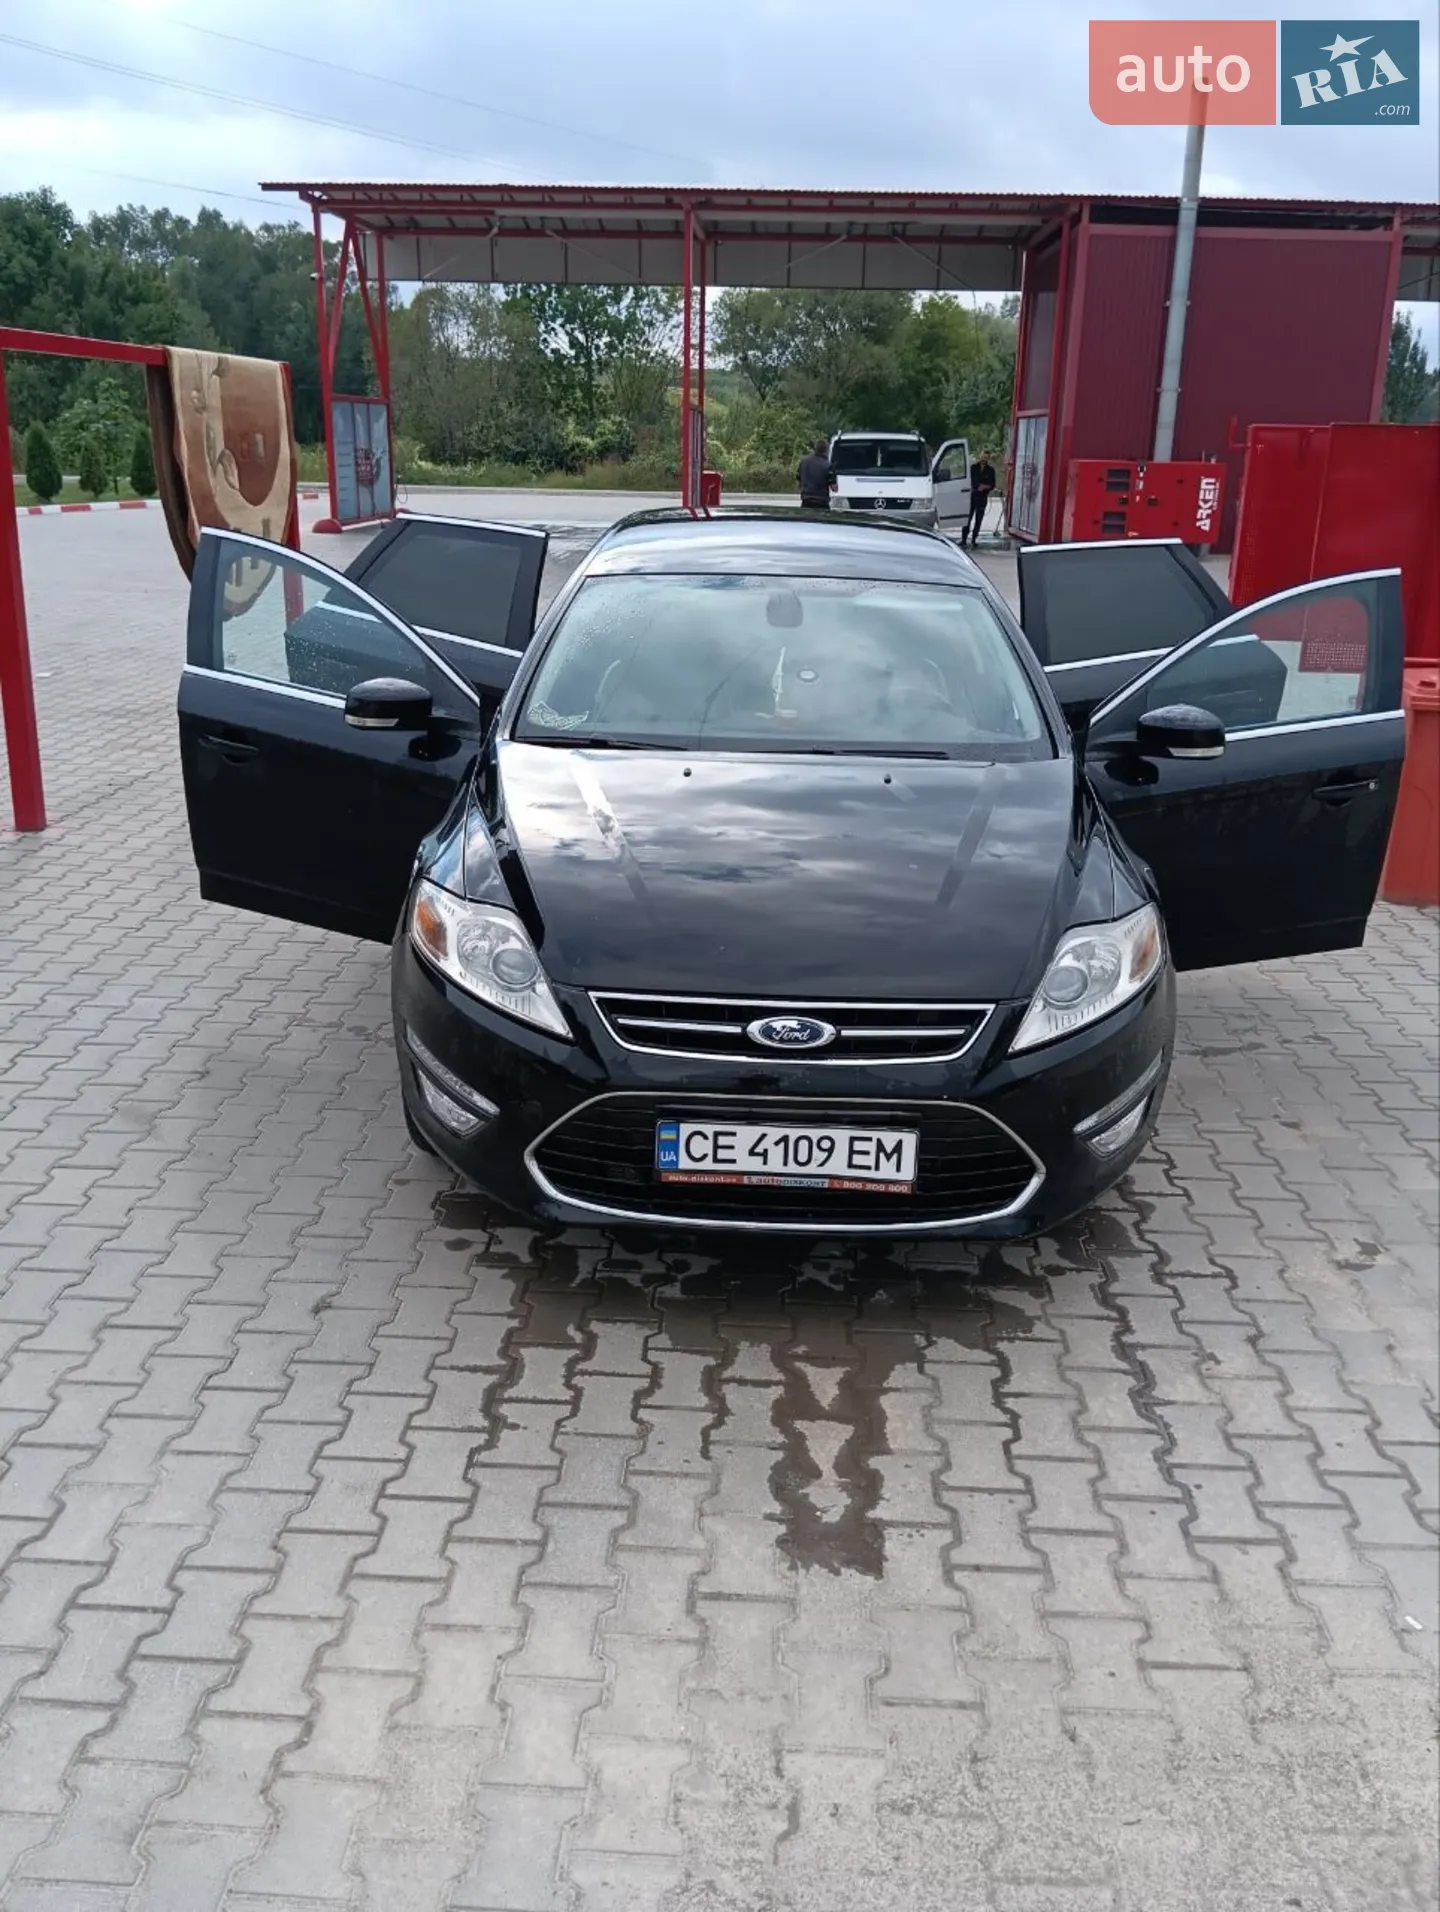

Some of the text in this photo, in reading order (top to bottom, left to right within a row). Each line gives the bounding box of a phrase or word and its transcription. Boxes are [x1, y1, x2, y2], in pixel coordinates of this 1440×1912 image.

[1196, 476, 1216, 532] ARKEN
[771, 1024, 811, 1041] Ford
[660, 1150, 677, 1162] UA
[684, 1129, 903, 1173] CE 4109 EM
